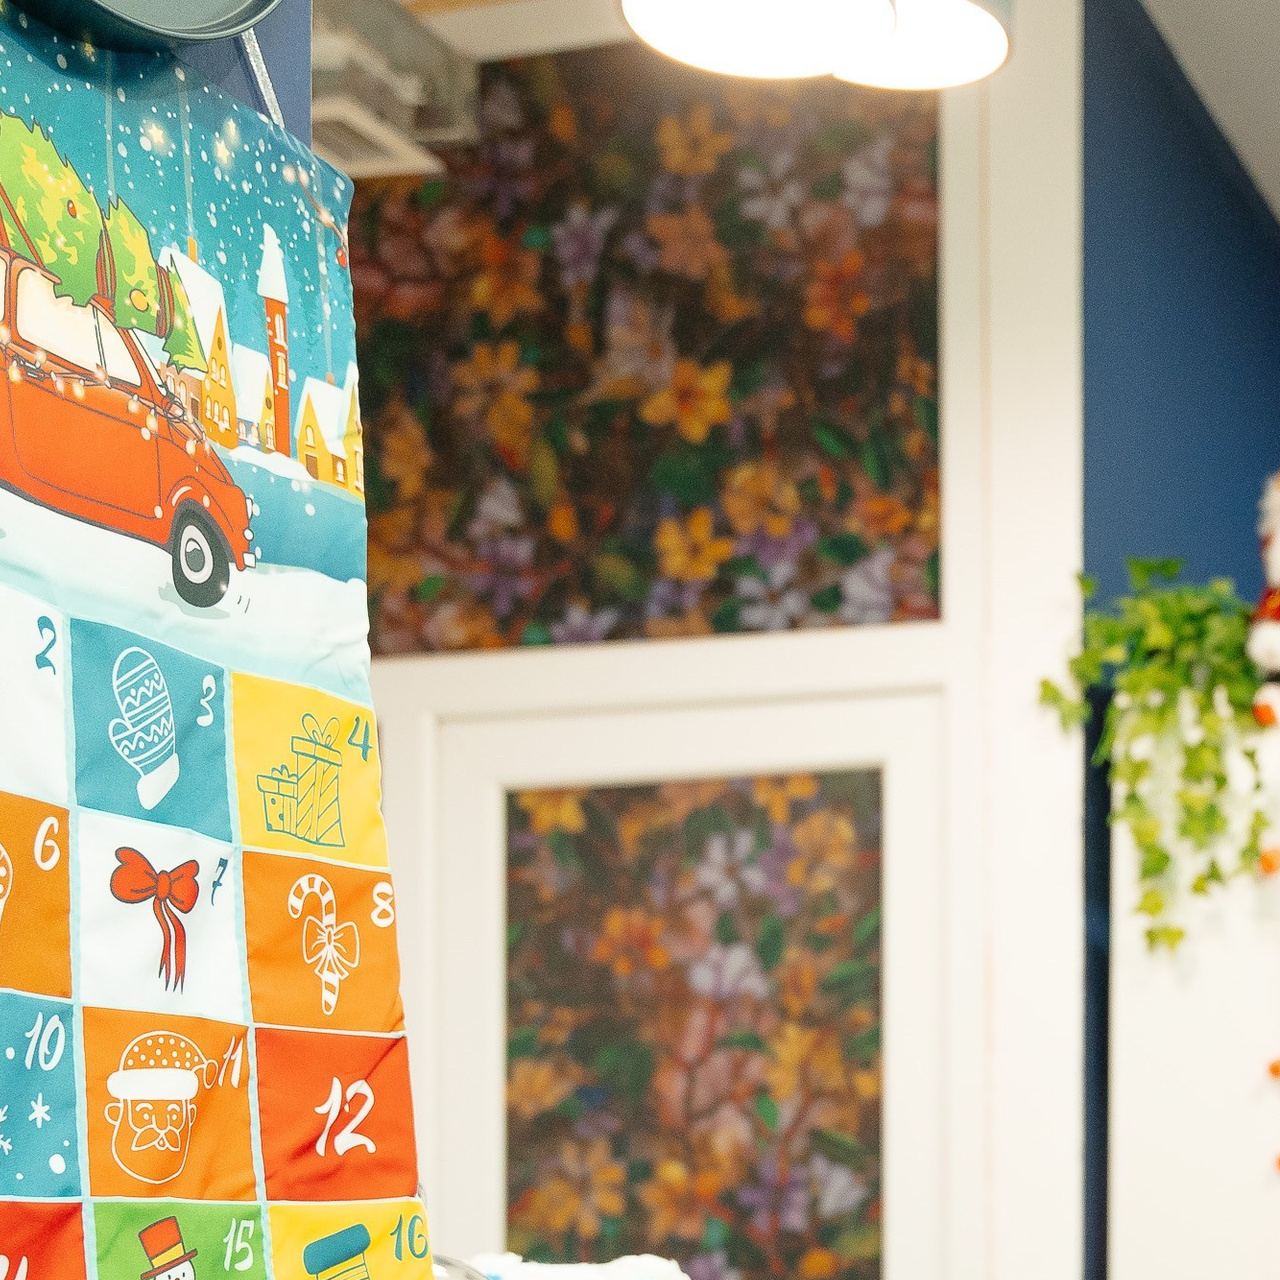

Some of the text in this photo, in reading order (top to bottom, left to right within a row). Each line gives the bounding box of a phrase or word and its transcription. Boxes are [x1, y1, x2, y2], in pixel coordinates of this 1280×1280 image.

[36, 616, 56, 675] 2
[197, 675, 215, 727] 3
[348, 717, 372, 761] 4
[34, 817, 61, 870] 6
[211, 858, 228, 905] 7
[371, 881, 395, 928] 8
[24, 1012, 65, 1071] 10
[218, 1035, 243, 1088] 11
[313, 1077, 376, 1156] 12
[223, 1217, 256, 1271] 15
[390, 1215, 427, 1260] 16
